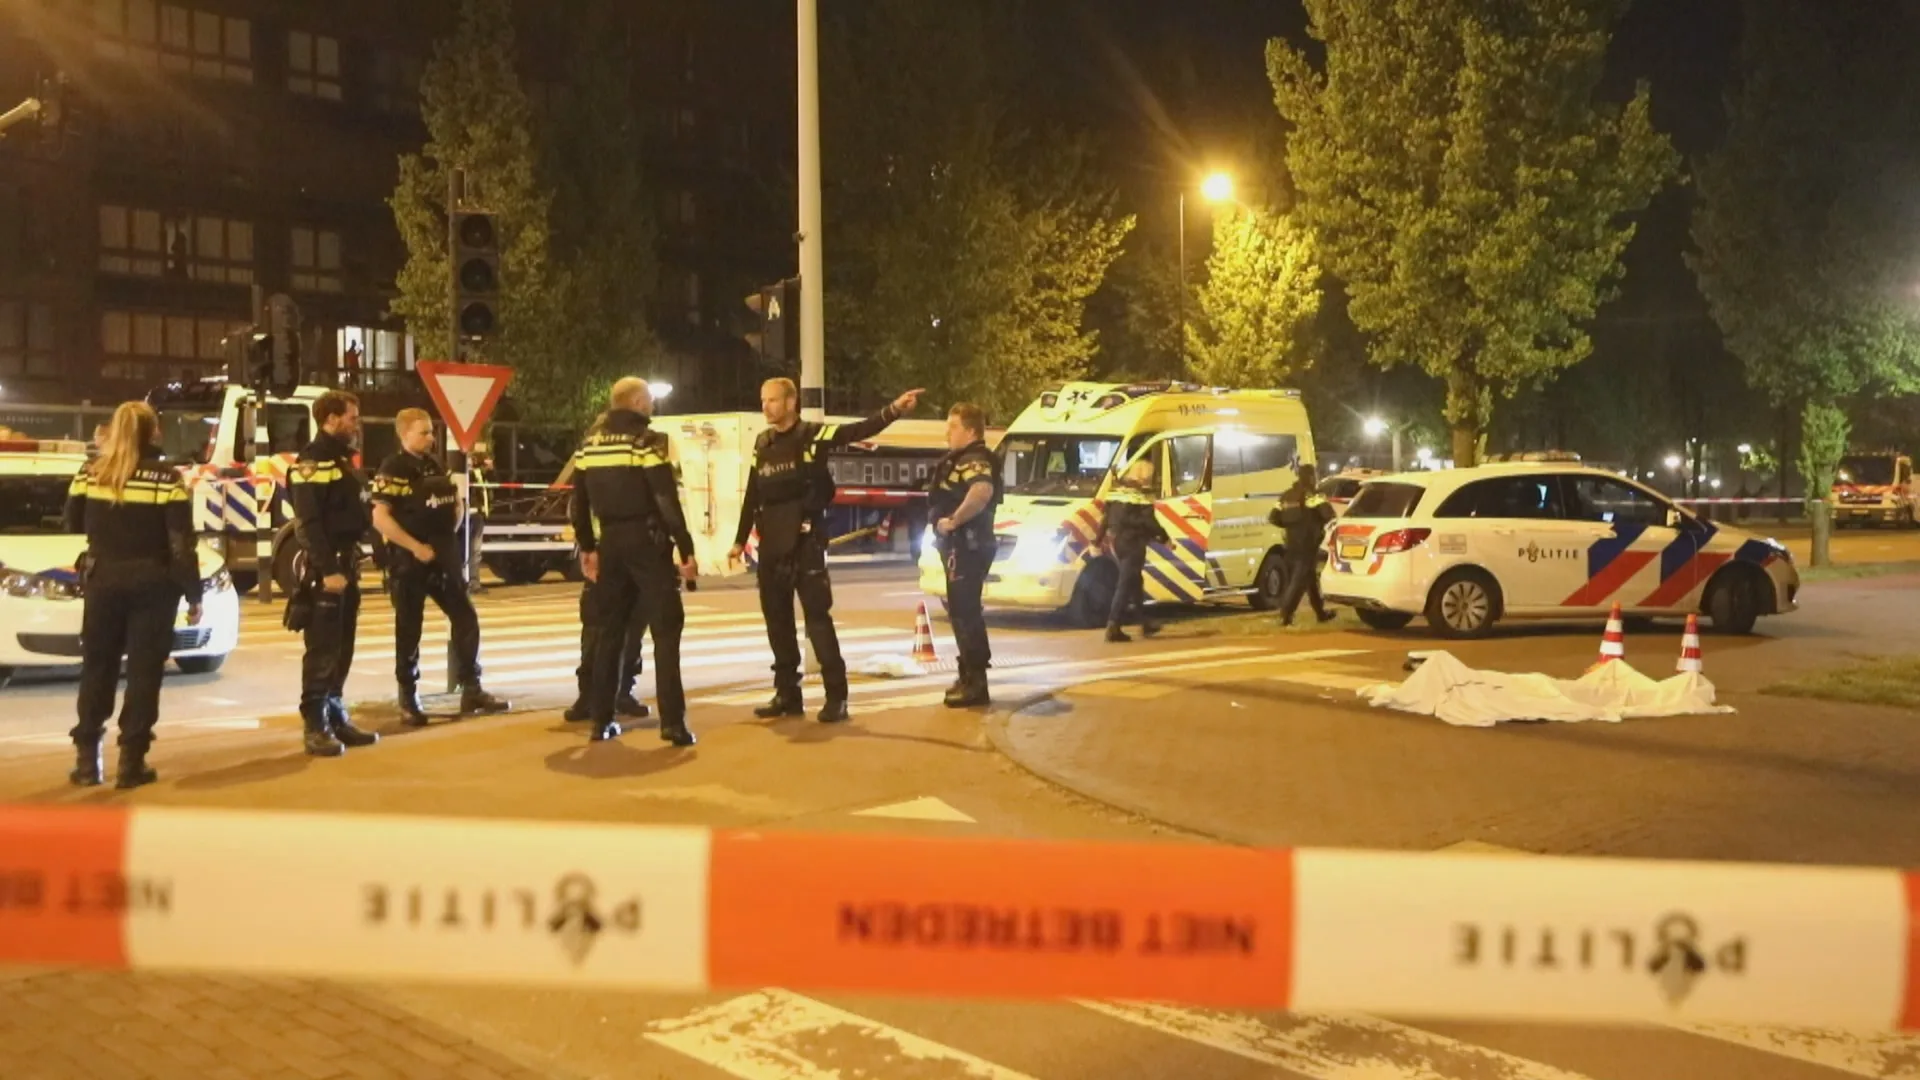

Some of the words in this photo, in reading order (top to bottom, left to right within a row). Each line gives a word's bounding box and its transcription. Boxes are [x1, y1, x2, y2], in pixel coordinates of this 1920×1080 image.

[1518, 542, 1578, 563] POLITIE
[357, 872, 643, 958] POLITIE
[837, 900, 1123, 955] BETREDEN
[1138, 910, 1256, 959] NIET
[1455, 911, 1748, 996] POLITIE
